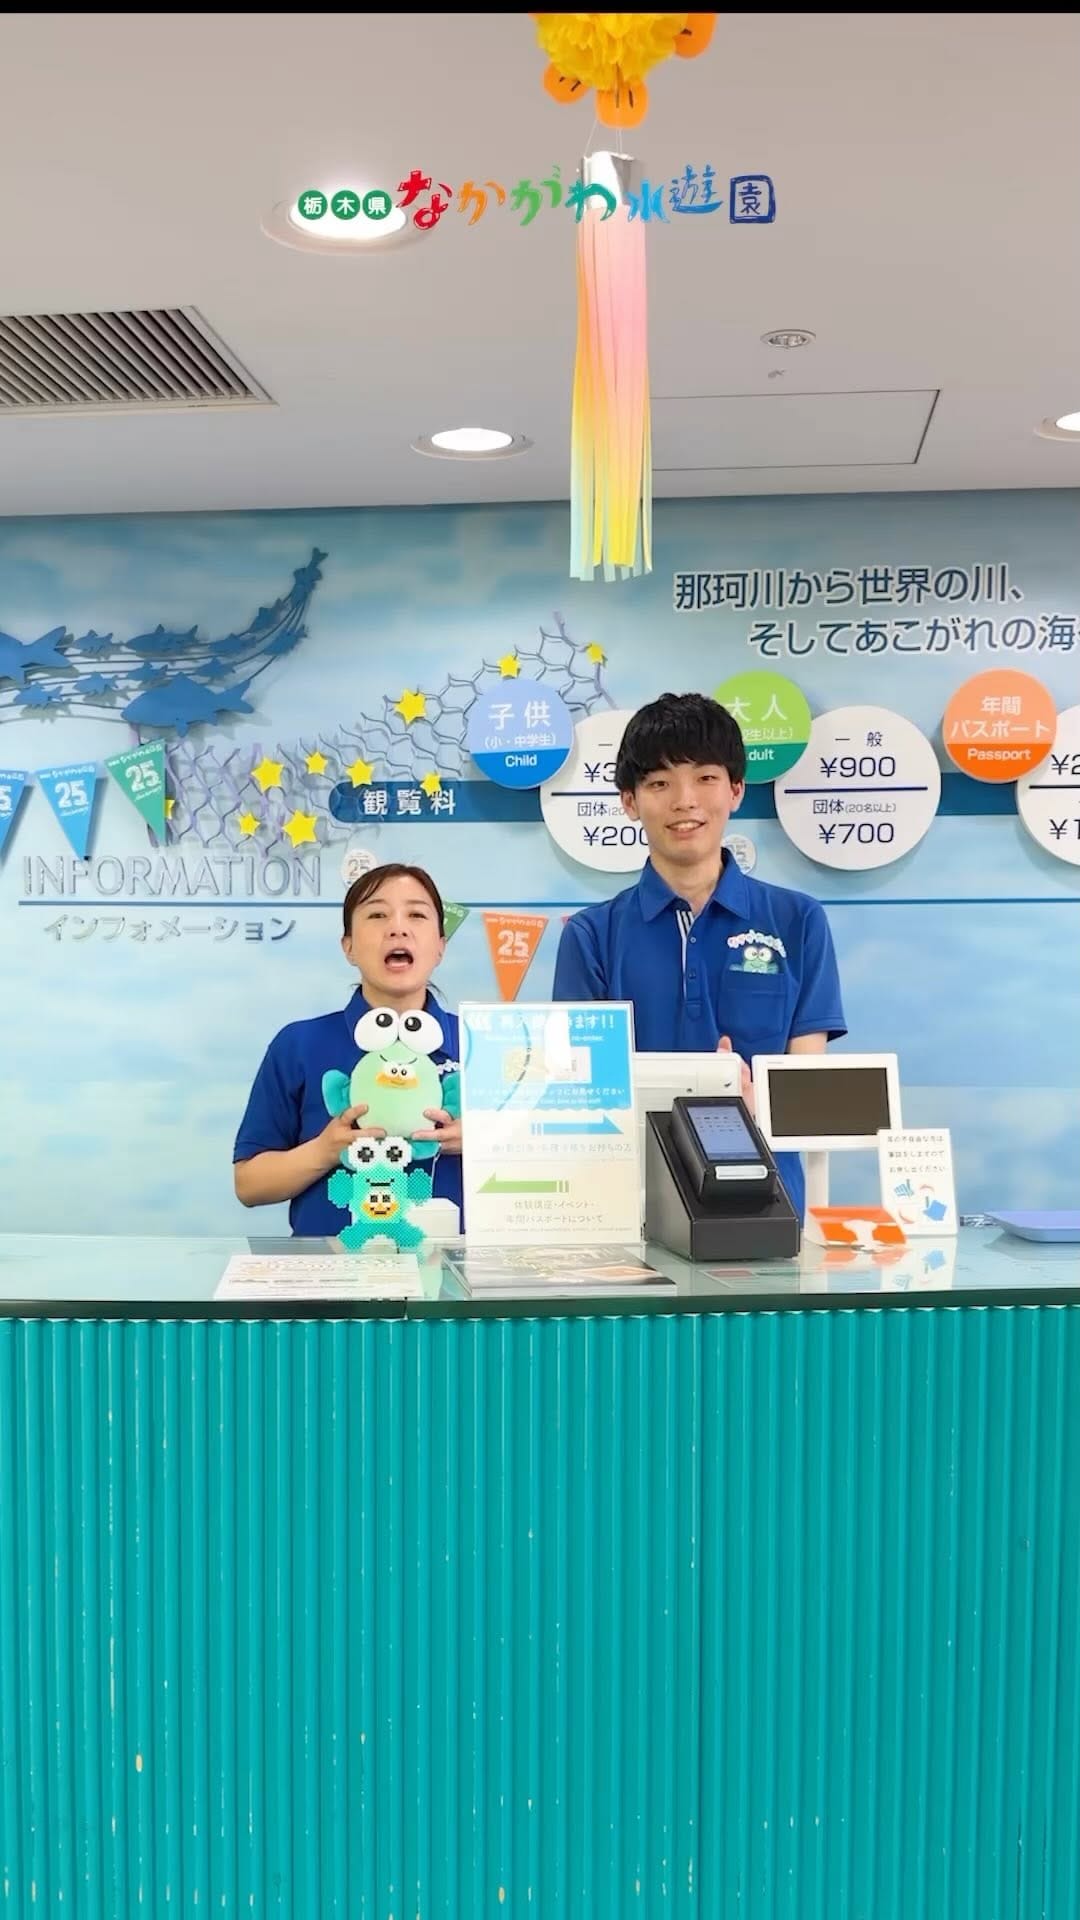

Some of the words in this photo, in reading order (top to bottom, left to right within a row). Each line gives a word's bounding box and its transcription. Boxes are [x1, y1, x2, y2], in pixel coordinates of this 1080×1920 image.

[676, 565, 1022, 609] 那珂川から世界の川、
[750, 616, 1080, 656] そしてあこがれの海
[488, 701, 552, 730] 子供
[723, 694, 788, 722] 大人
[981, 695, 1022, 716] 年間
[835, 731, 883, 747] 一般
[950, 719, 1051, 738] パスポート
[505, 754, 538, 768] Child
[746, 748, 775, 761] dult
[820, 756, 896, 778] ¥900
[967, 748, 1032, 762] Passport
[125, 760, 160, 793] 25
[55, 780, 88, 809] 25
[363, 789, 456, 815] 観覧料
[818, 822, 894, 844] ¥700
[23, 855, 321, 896] INFORMATION
[44, 915, 297, 941] インフォメーション
[497, 928, 530, 958] 25
